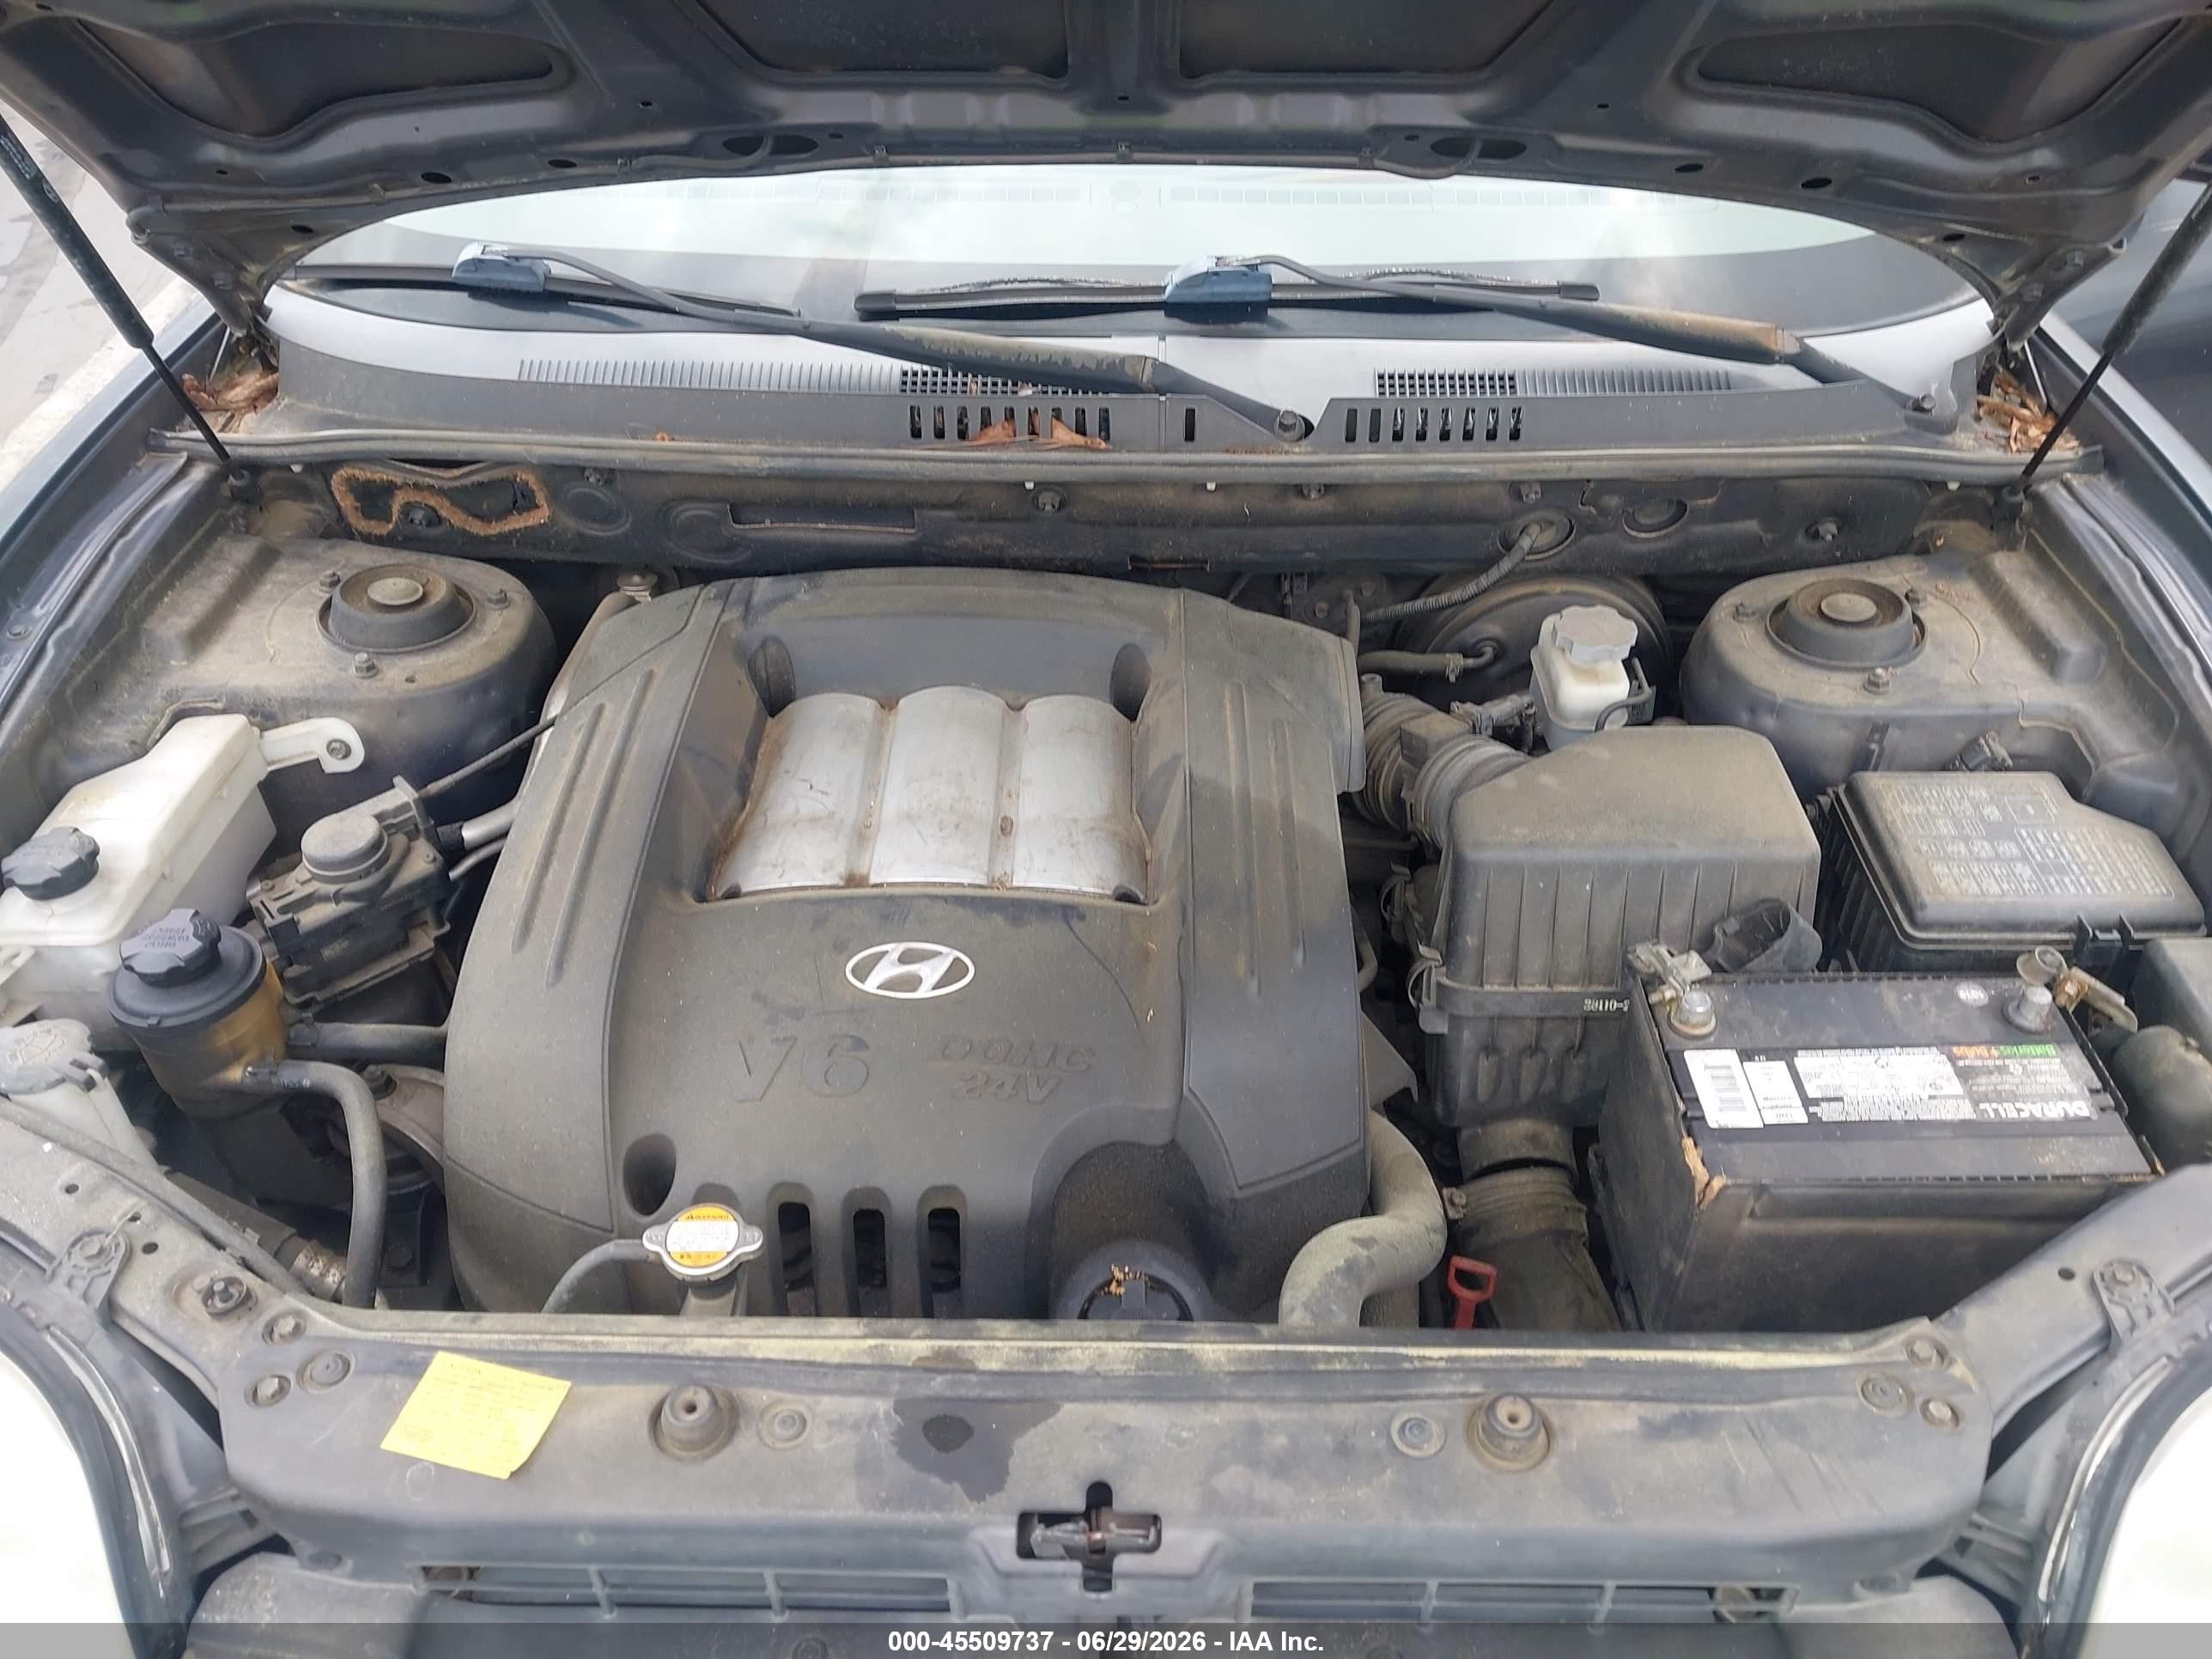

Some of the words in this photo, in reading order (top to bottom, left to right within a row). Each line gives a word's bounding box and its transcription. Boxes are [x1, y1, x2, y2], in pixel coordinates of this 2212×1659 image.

[726, 1035, 871, 1103] V6
[927, 1036, 1097, 1073] DOHC
[951, 1071, 1063, 1105] 24V
[1978, 1100, 2090, 1119] DURACELL
